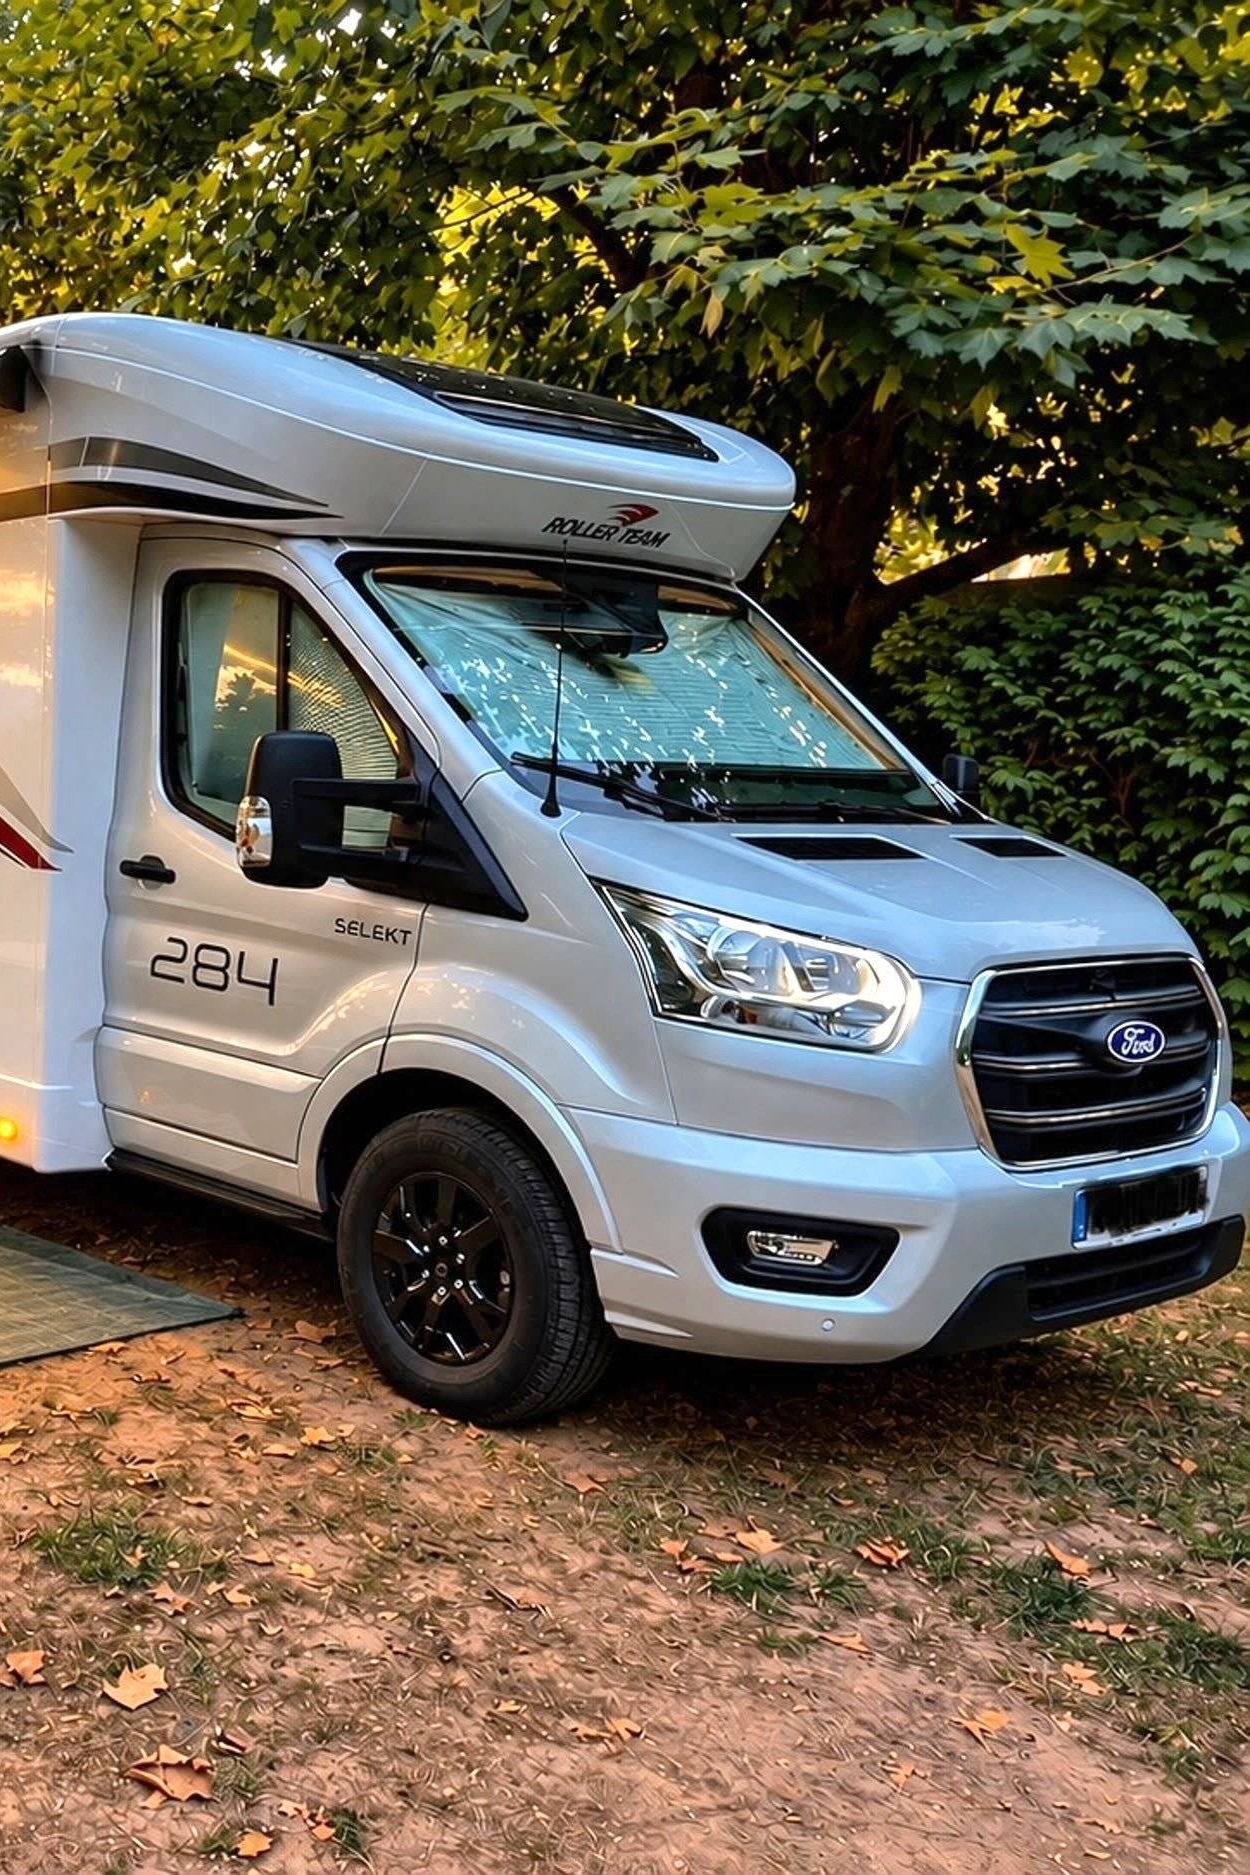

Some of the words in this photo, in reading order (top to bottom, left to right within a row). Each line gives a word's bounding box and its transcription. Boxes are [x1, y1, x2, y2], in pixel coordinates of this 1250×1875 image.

[541, 517, 619, 541] ROLLER
[618, 528, 670, 548] TEAM
[334, 917, 412, 946] SELEKT
[150, 936, 278, 1006] 284
[1121, 1027, 1155, 1055] Ford
